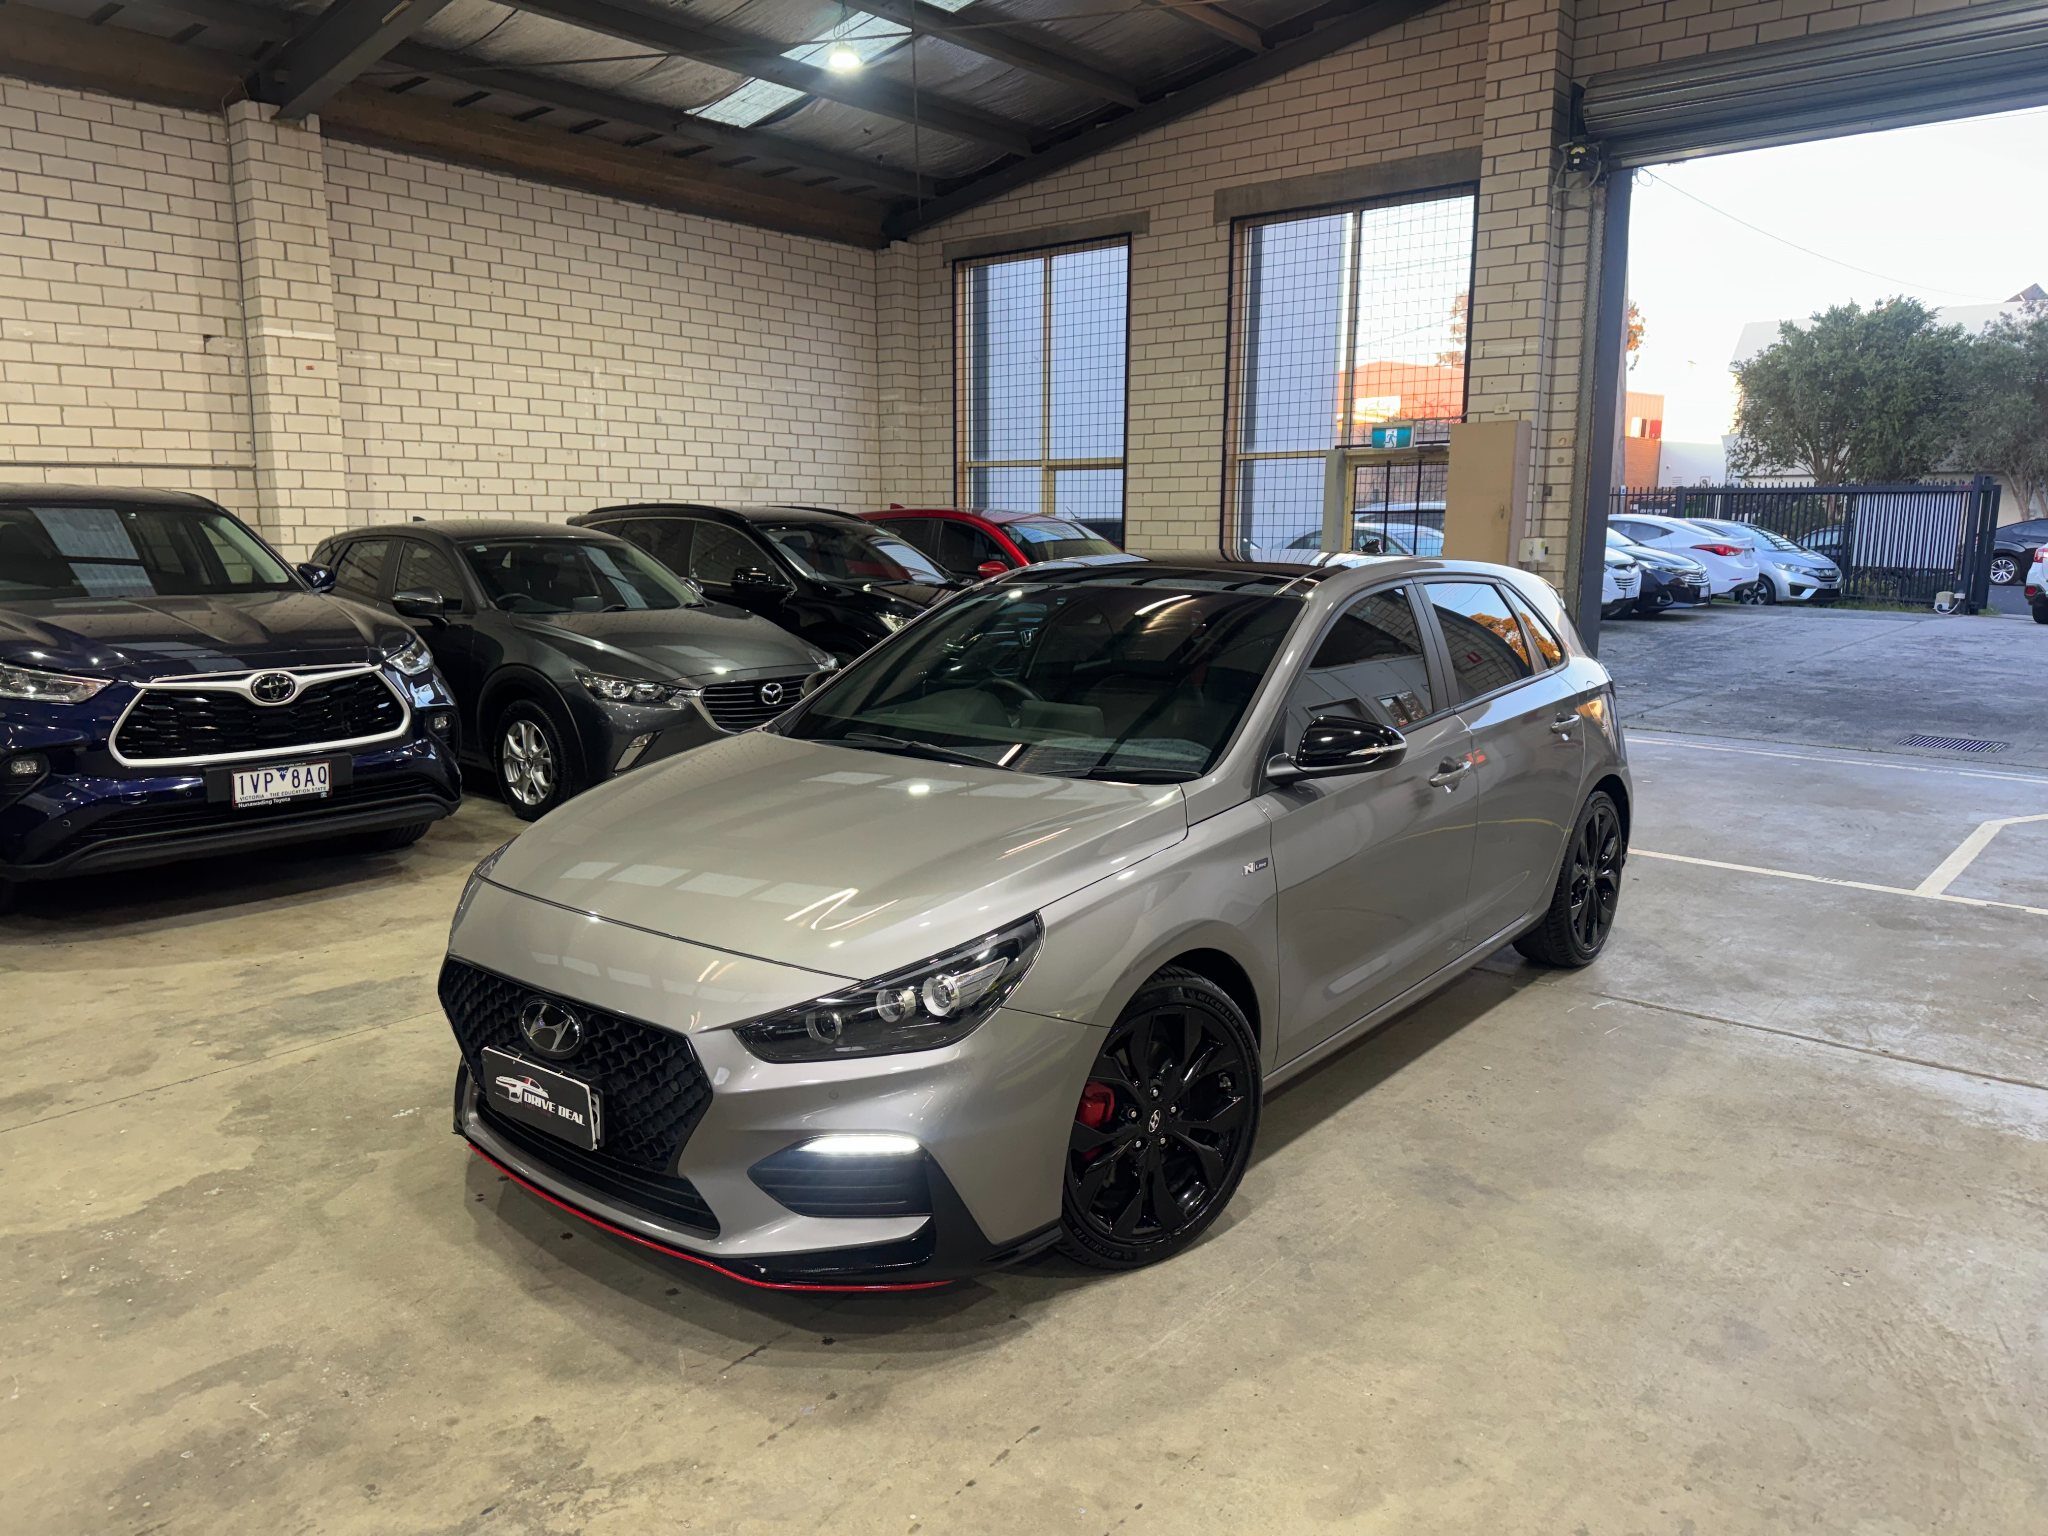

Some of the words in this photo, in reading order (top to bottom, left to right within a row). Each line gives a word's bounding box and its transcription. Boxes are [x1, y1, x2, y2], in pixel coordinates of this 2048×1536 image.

[239, 773, 274, 796] 1VP
[291, 766, 327, 789] 8AQ
[524, 1091, 555, 1114] DRIVE
[558, 1105, 585, 1126] DEAL
